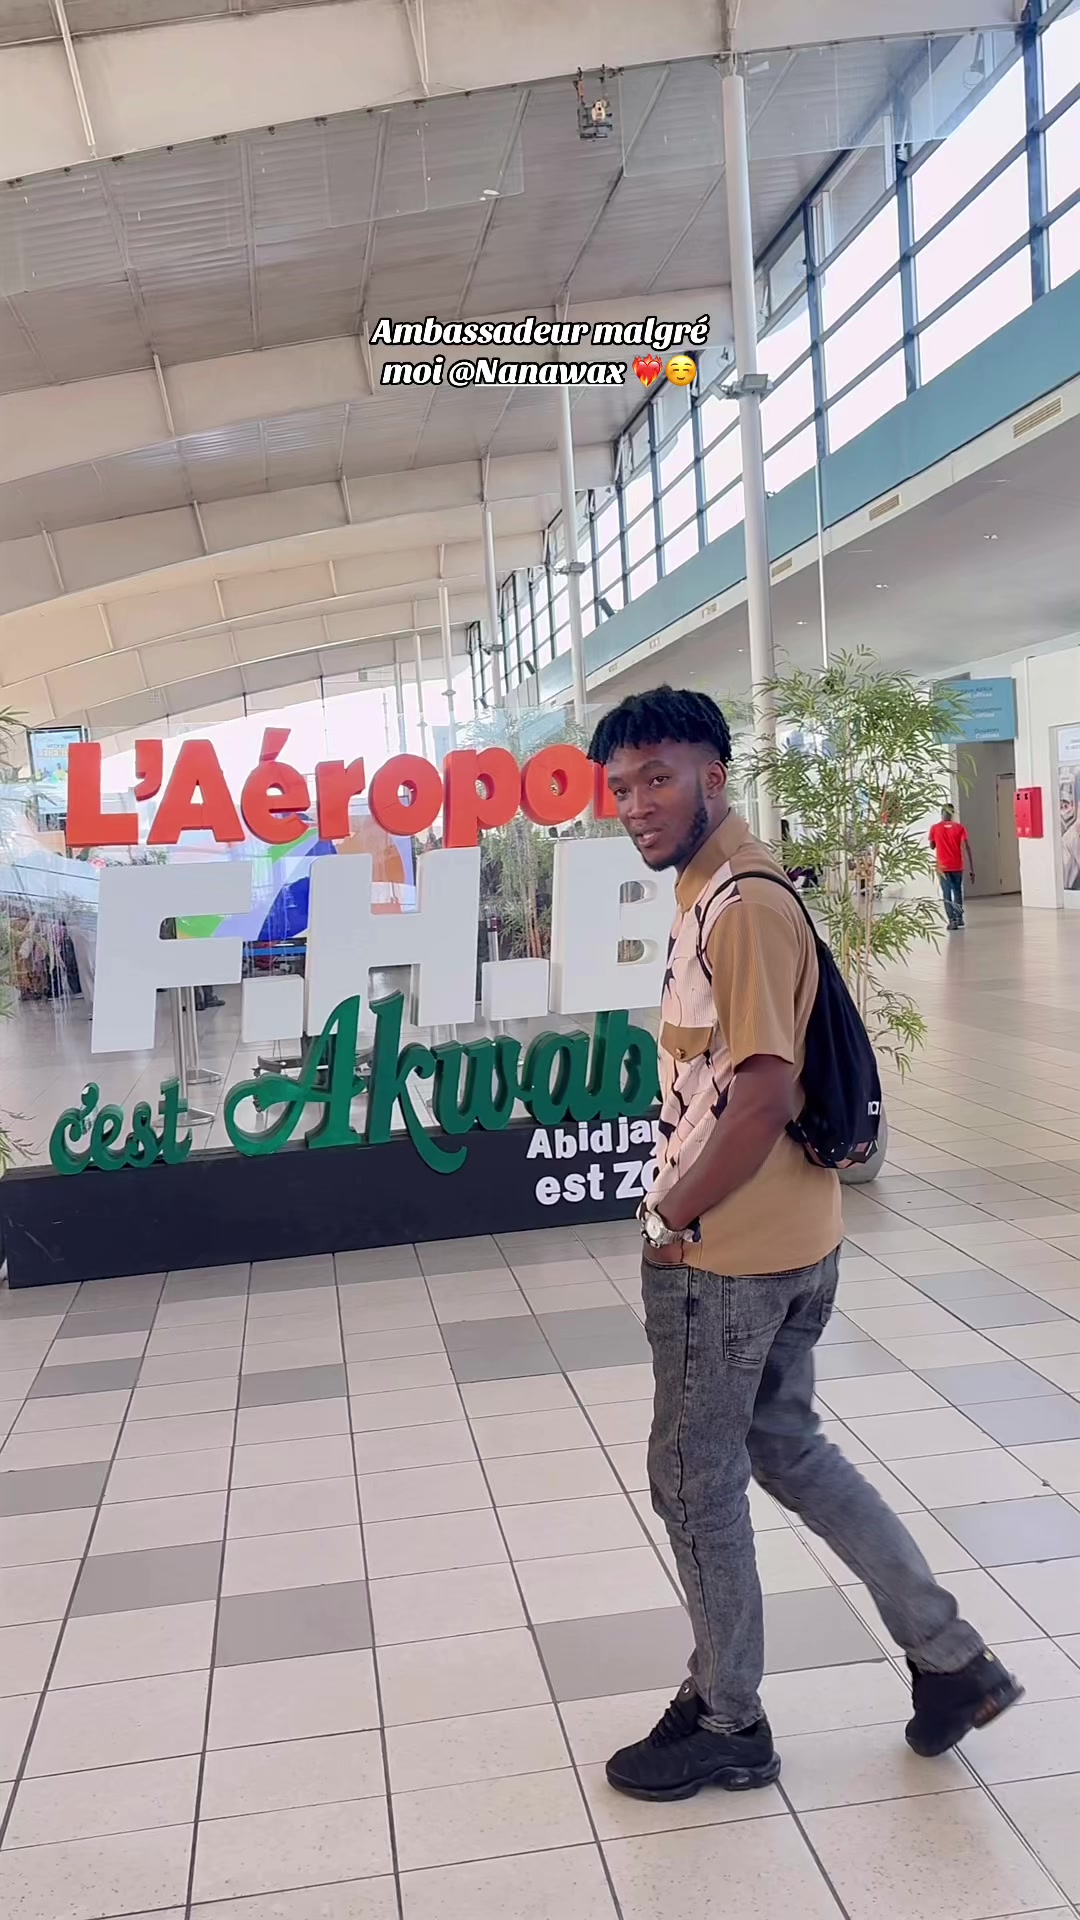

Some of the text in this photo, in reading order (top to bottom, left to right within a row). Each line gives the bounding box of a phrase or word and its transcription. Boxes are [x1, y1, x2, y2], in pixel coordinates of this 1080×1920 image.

[65, 727, 618, 848] L'Aéropo
[49, 991, 661, 1176] c'est Akwab
[535, 1163, 605, 1205] est
